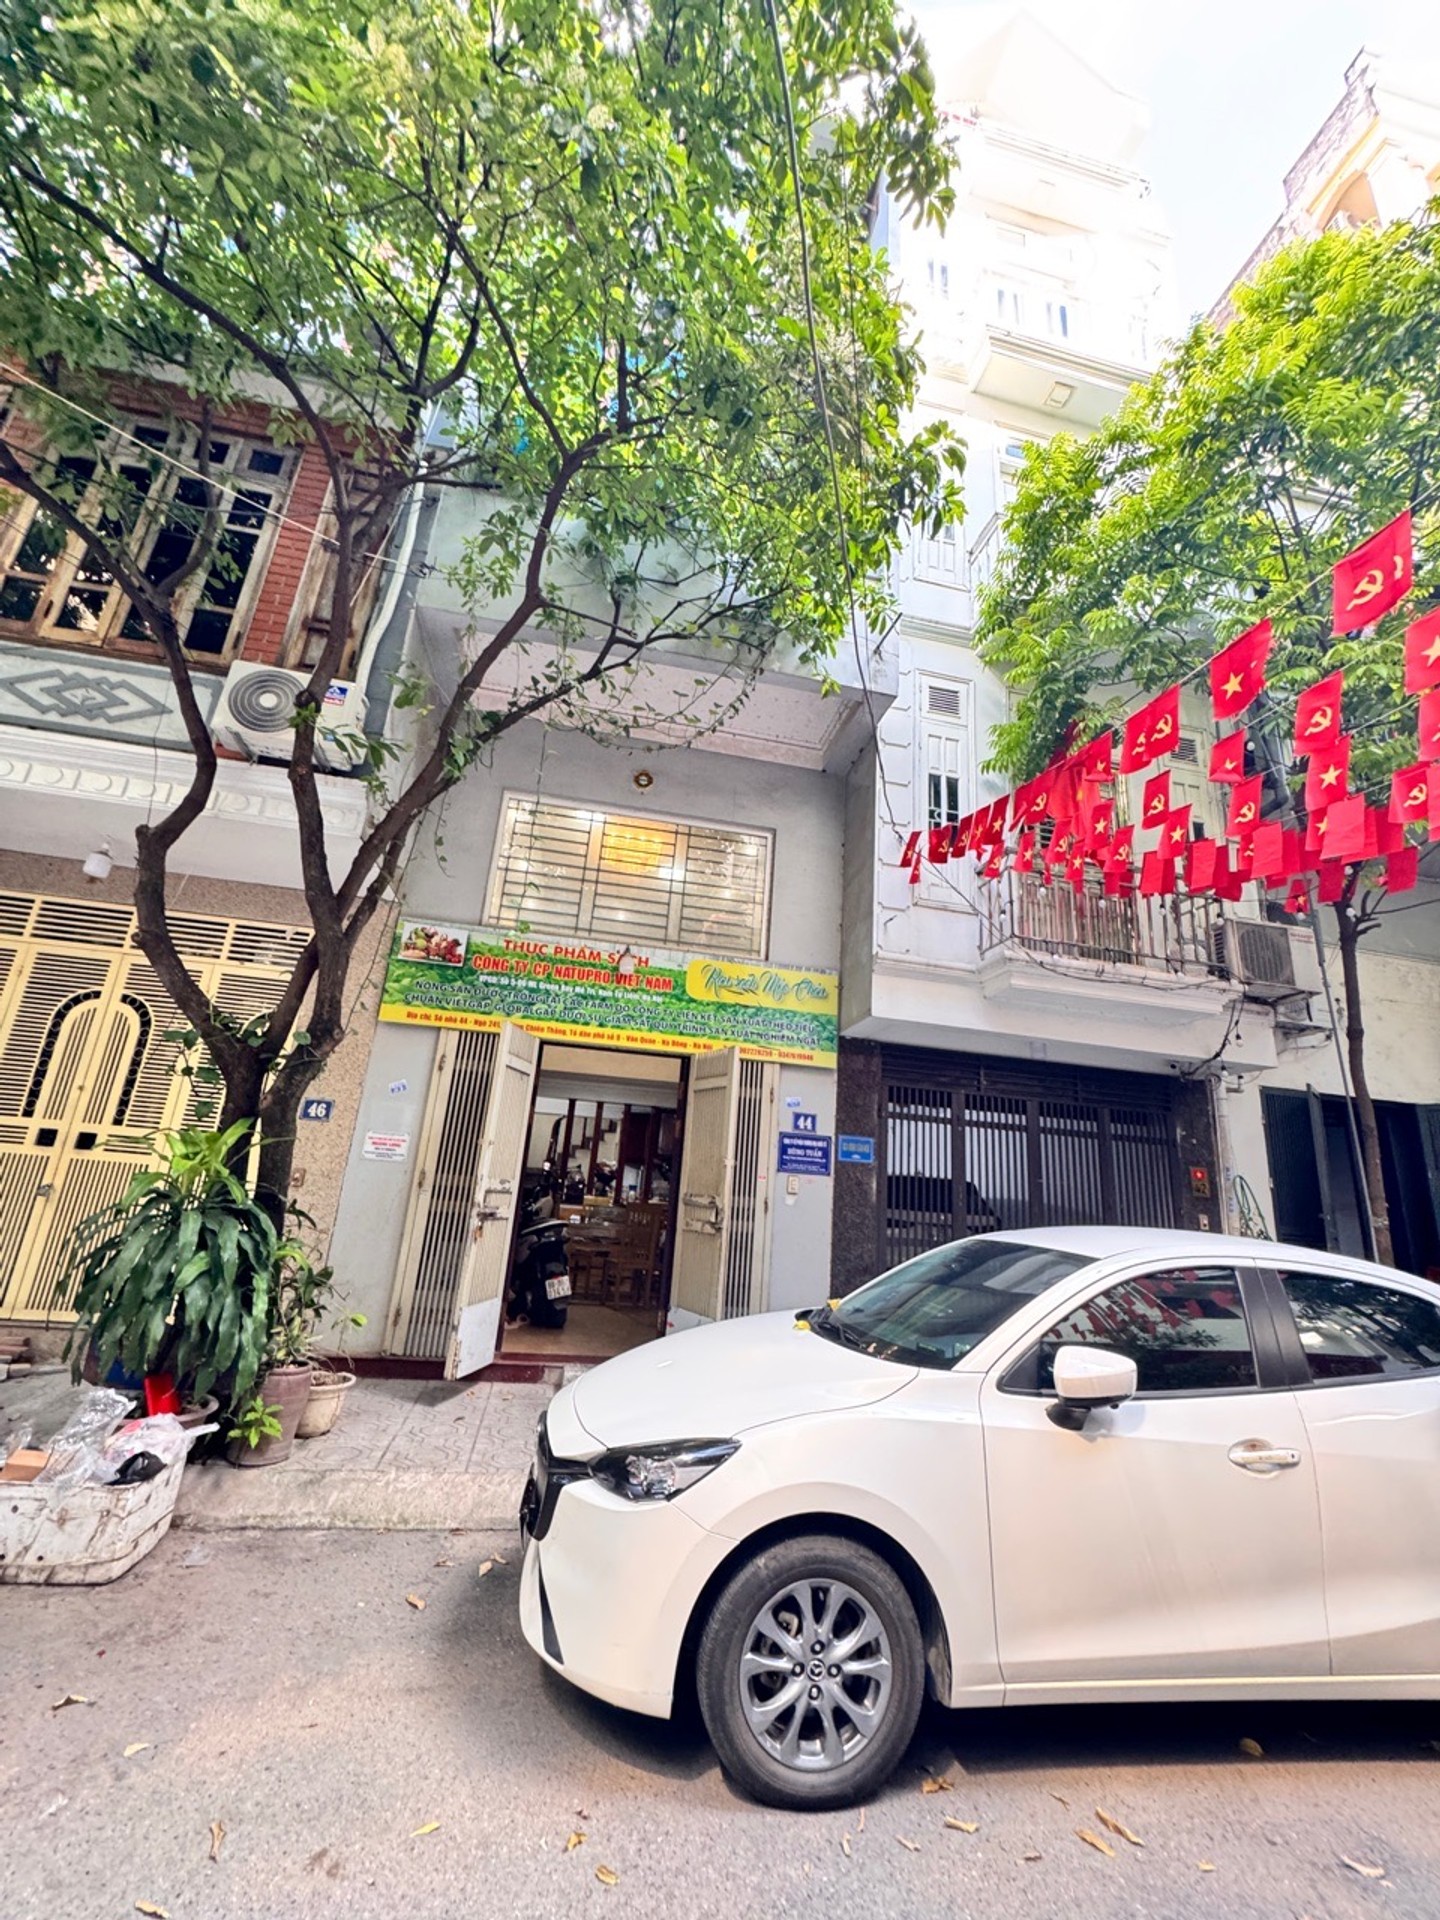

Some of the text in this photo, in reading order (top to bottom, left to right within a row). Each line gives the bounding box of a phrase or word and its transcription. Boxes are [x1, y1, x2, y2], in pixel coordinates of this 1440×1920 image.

[514, 960, 529, 973] TY
[533, 962, 550, 976] CP
[554, 965, 611, 984] NATUPRO
[645, 977, 673, 991] NAM
[308, 1102, 326, 1117] 46
[797, 1115, 812, 1130] 44
